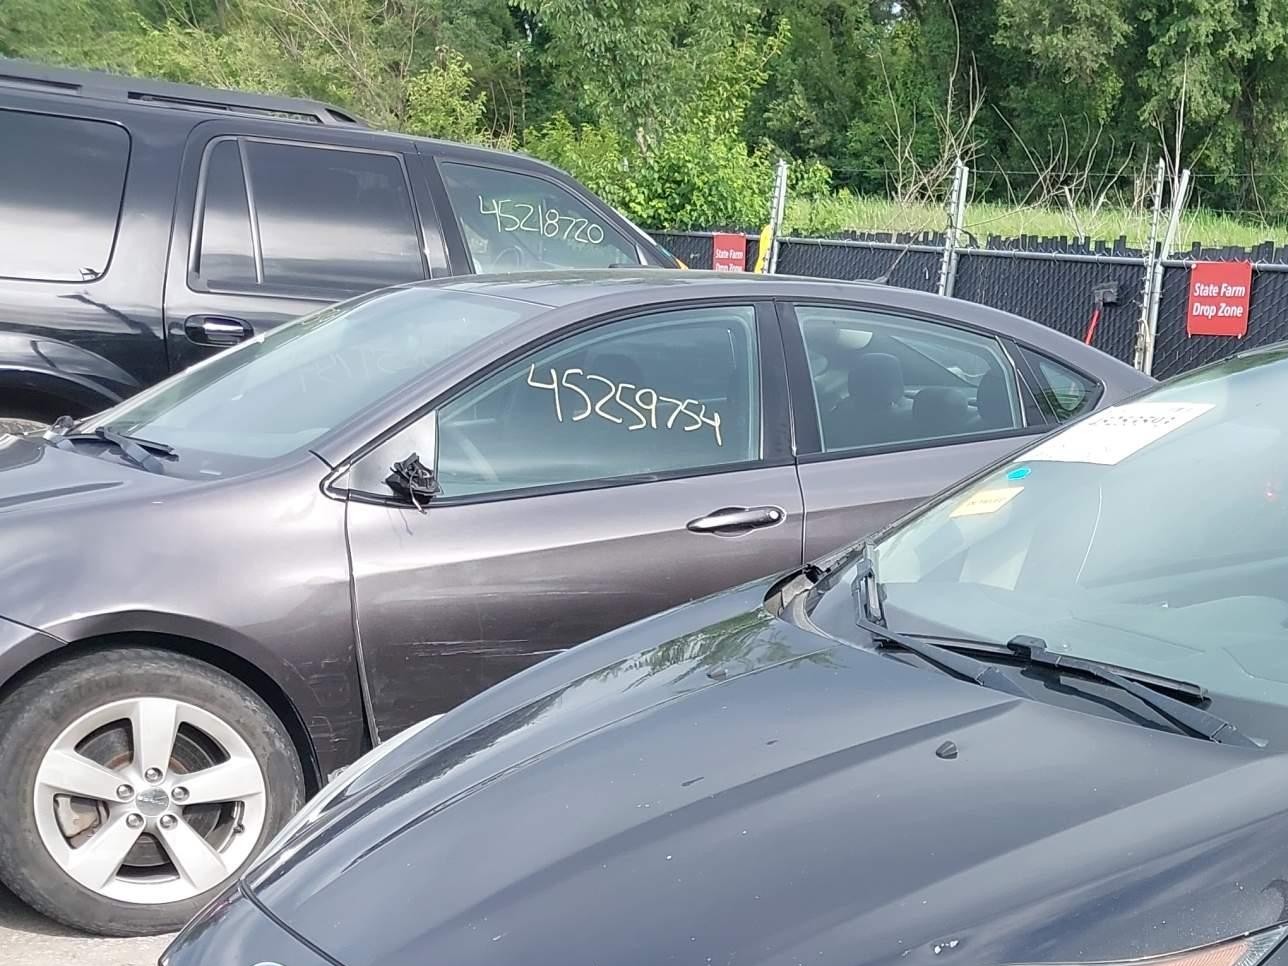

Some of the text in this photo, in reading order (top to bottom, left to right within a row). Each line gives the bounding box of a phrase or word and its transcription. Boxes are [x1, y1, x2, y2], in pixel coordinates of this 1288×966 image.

[479, 195, 604, 243] 45218720
[715, 249, 729, 259] State
[1193, 282, 1246, 297] State Farm
[1192, 302, 1244, 319] Drop Zone
[527, 363, 722, 446] 45259754
